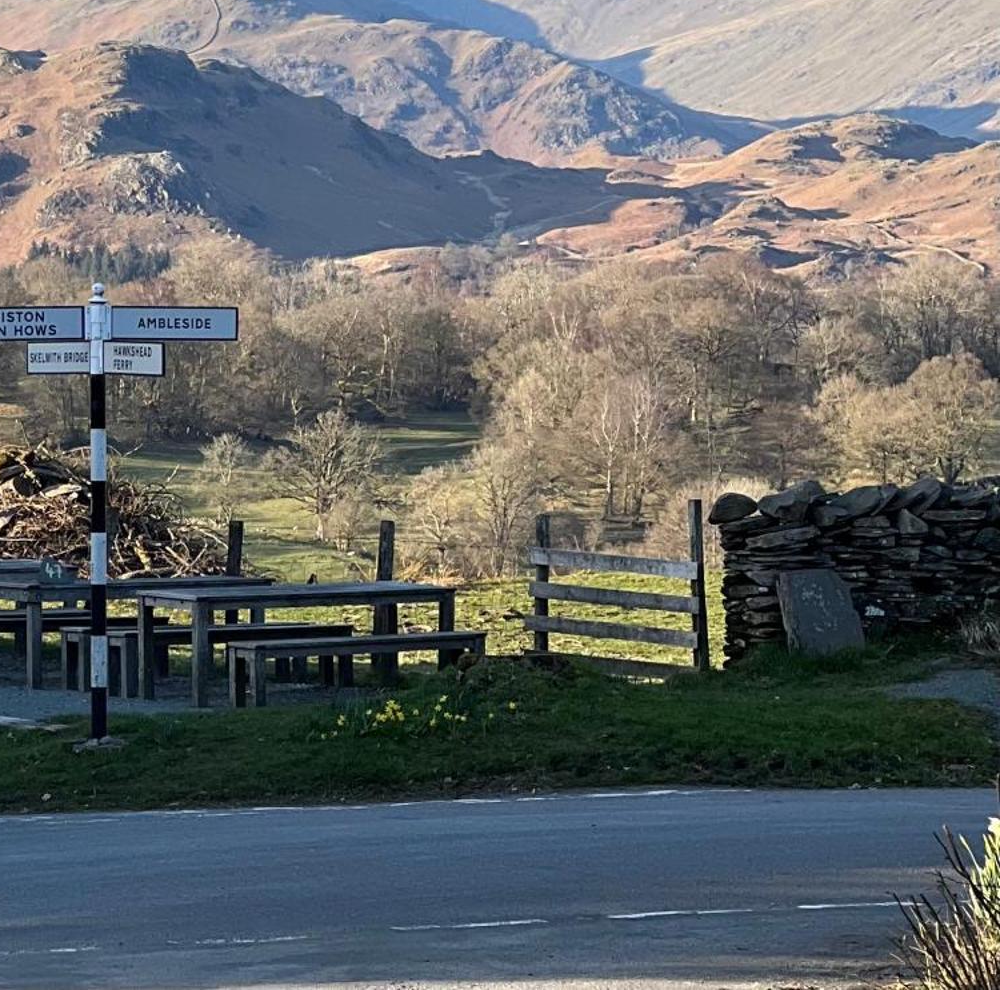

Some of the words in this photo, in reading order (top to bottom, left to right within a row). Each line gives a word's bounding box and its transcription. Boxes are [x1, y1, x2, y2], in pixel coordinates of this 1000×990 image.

[138, 318, 212, 329] AMBLESIDE
[14, 324, 57, 336] HOWS
[30, 352, 62, 363] SKELWITH
[64, 351, 89, 363] BRIDGE
[113, 345, 153, 357] HAWKSHEAD
[113, 359, 133, 370] FERRY
